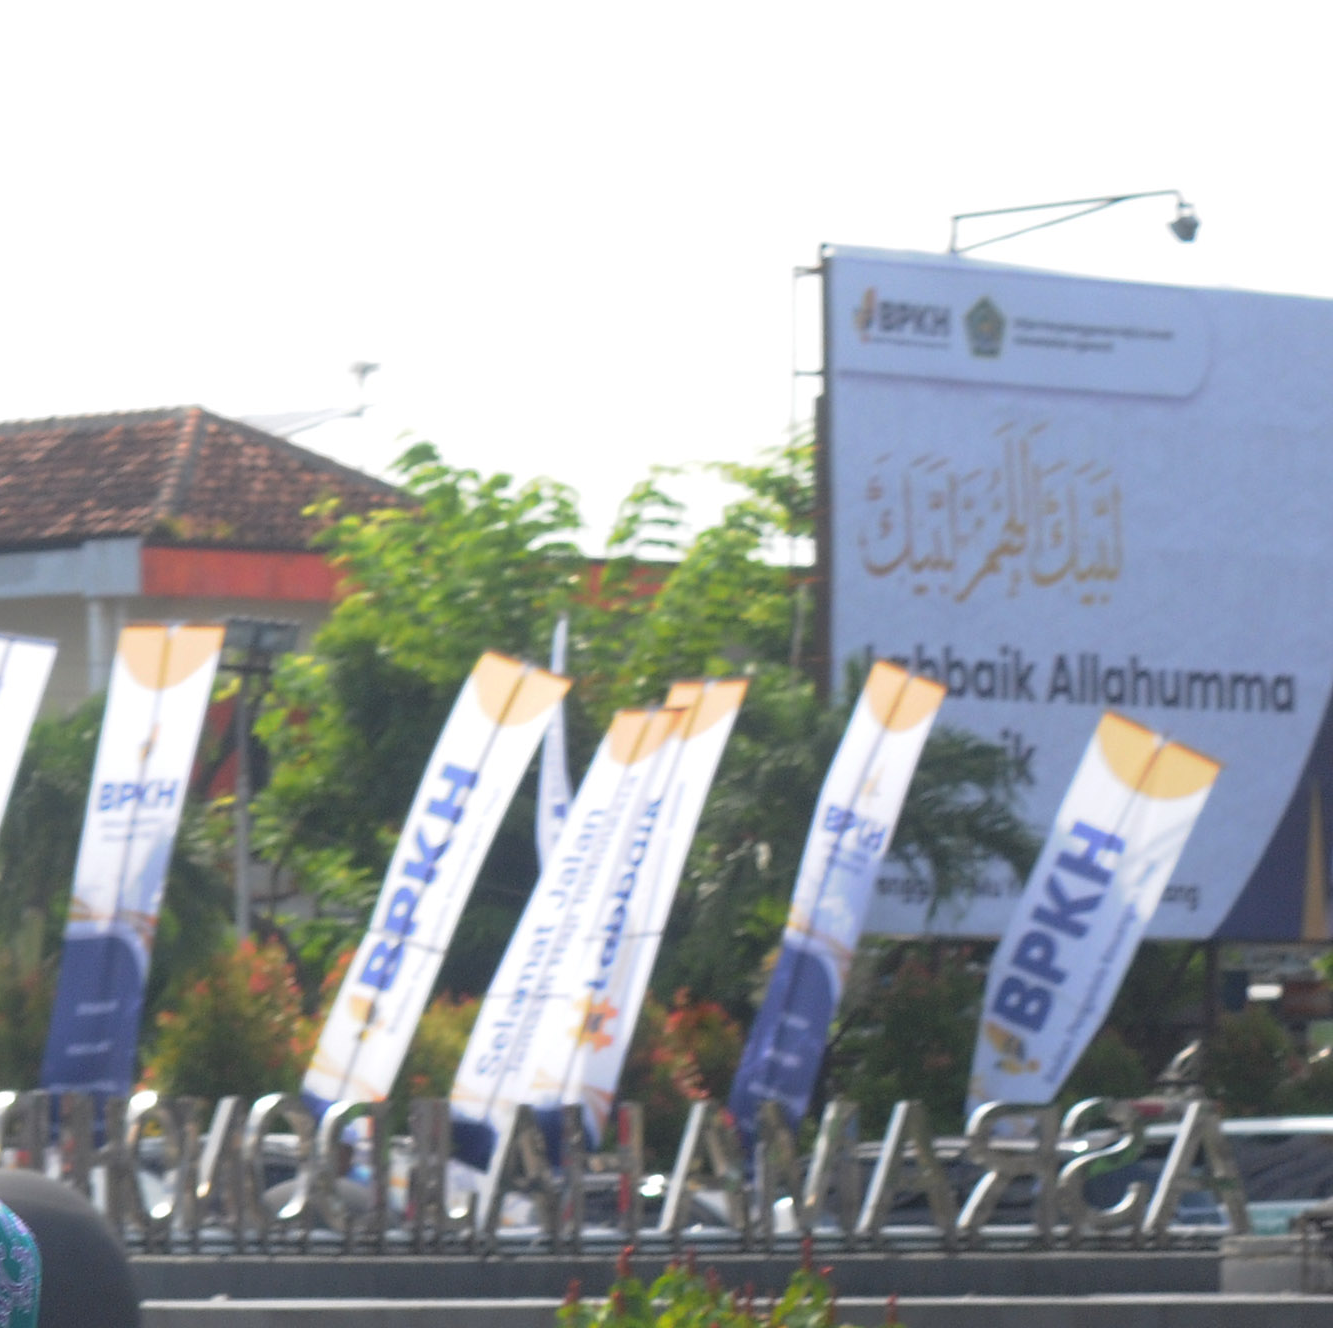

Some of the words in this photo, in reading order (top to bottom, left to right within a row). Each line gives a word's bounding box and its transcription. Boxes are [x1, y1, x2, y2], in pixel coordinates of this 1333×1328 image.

[1047, 654, 1295, 712] Allahumma
[98, 780, 179, 812] BPKH
[359, 762, 479, 991] BPKH
[475, 925, 555, 1076] Selamat
[549, 810, 607, 911] Jalan
[992, 821, 1126, 1035] BPKH
